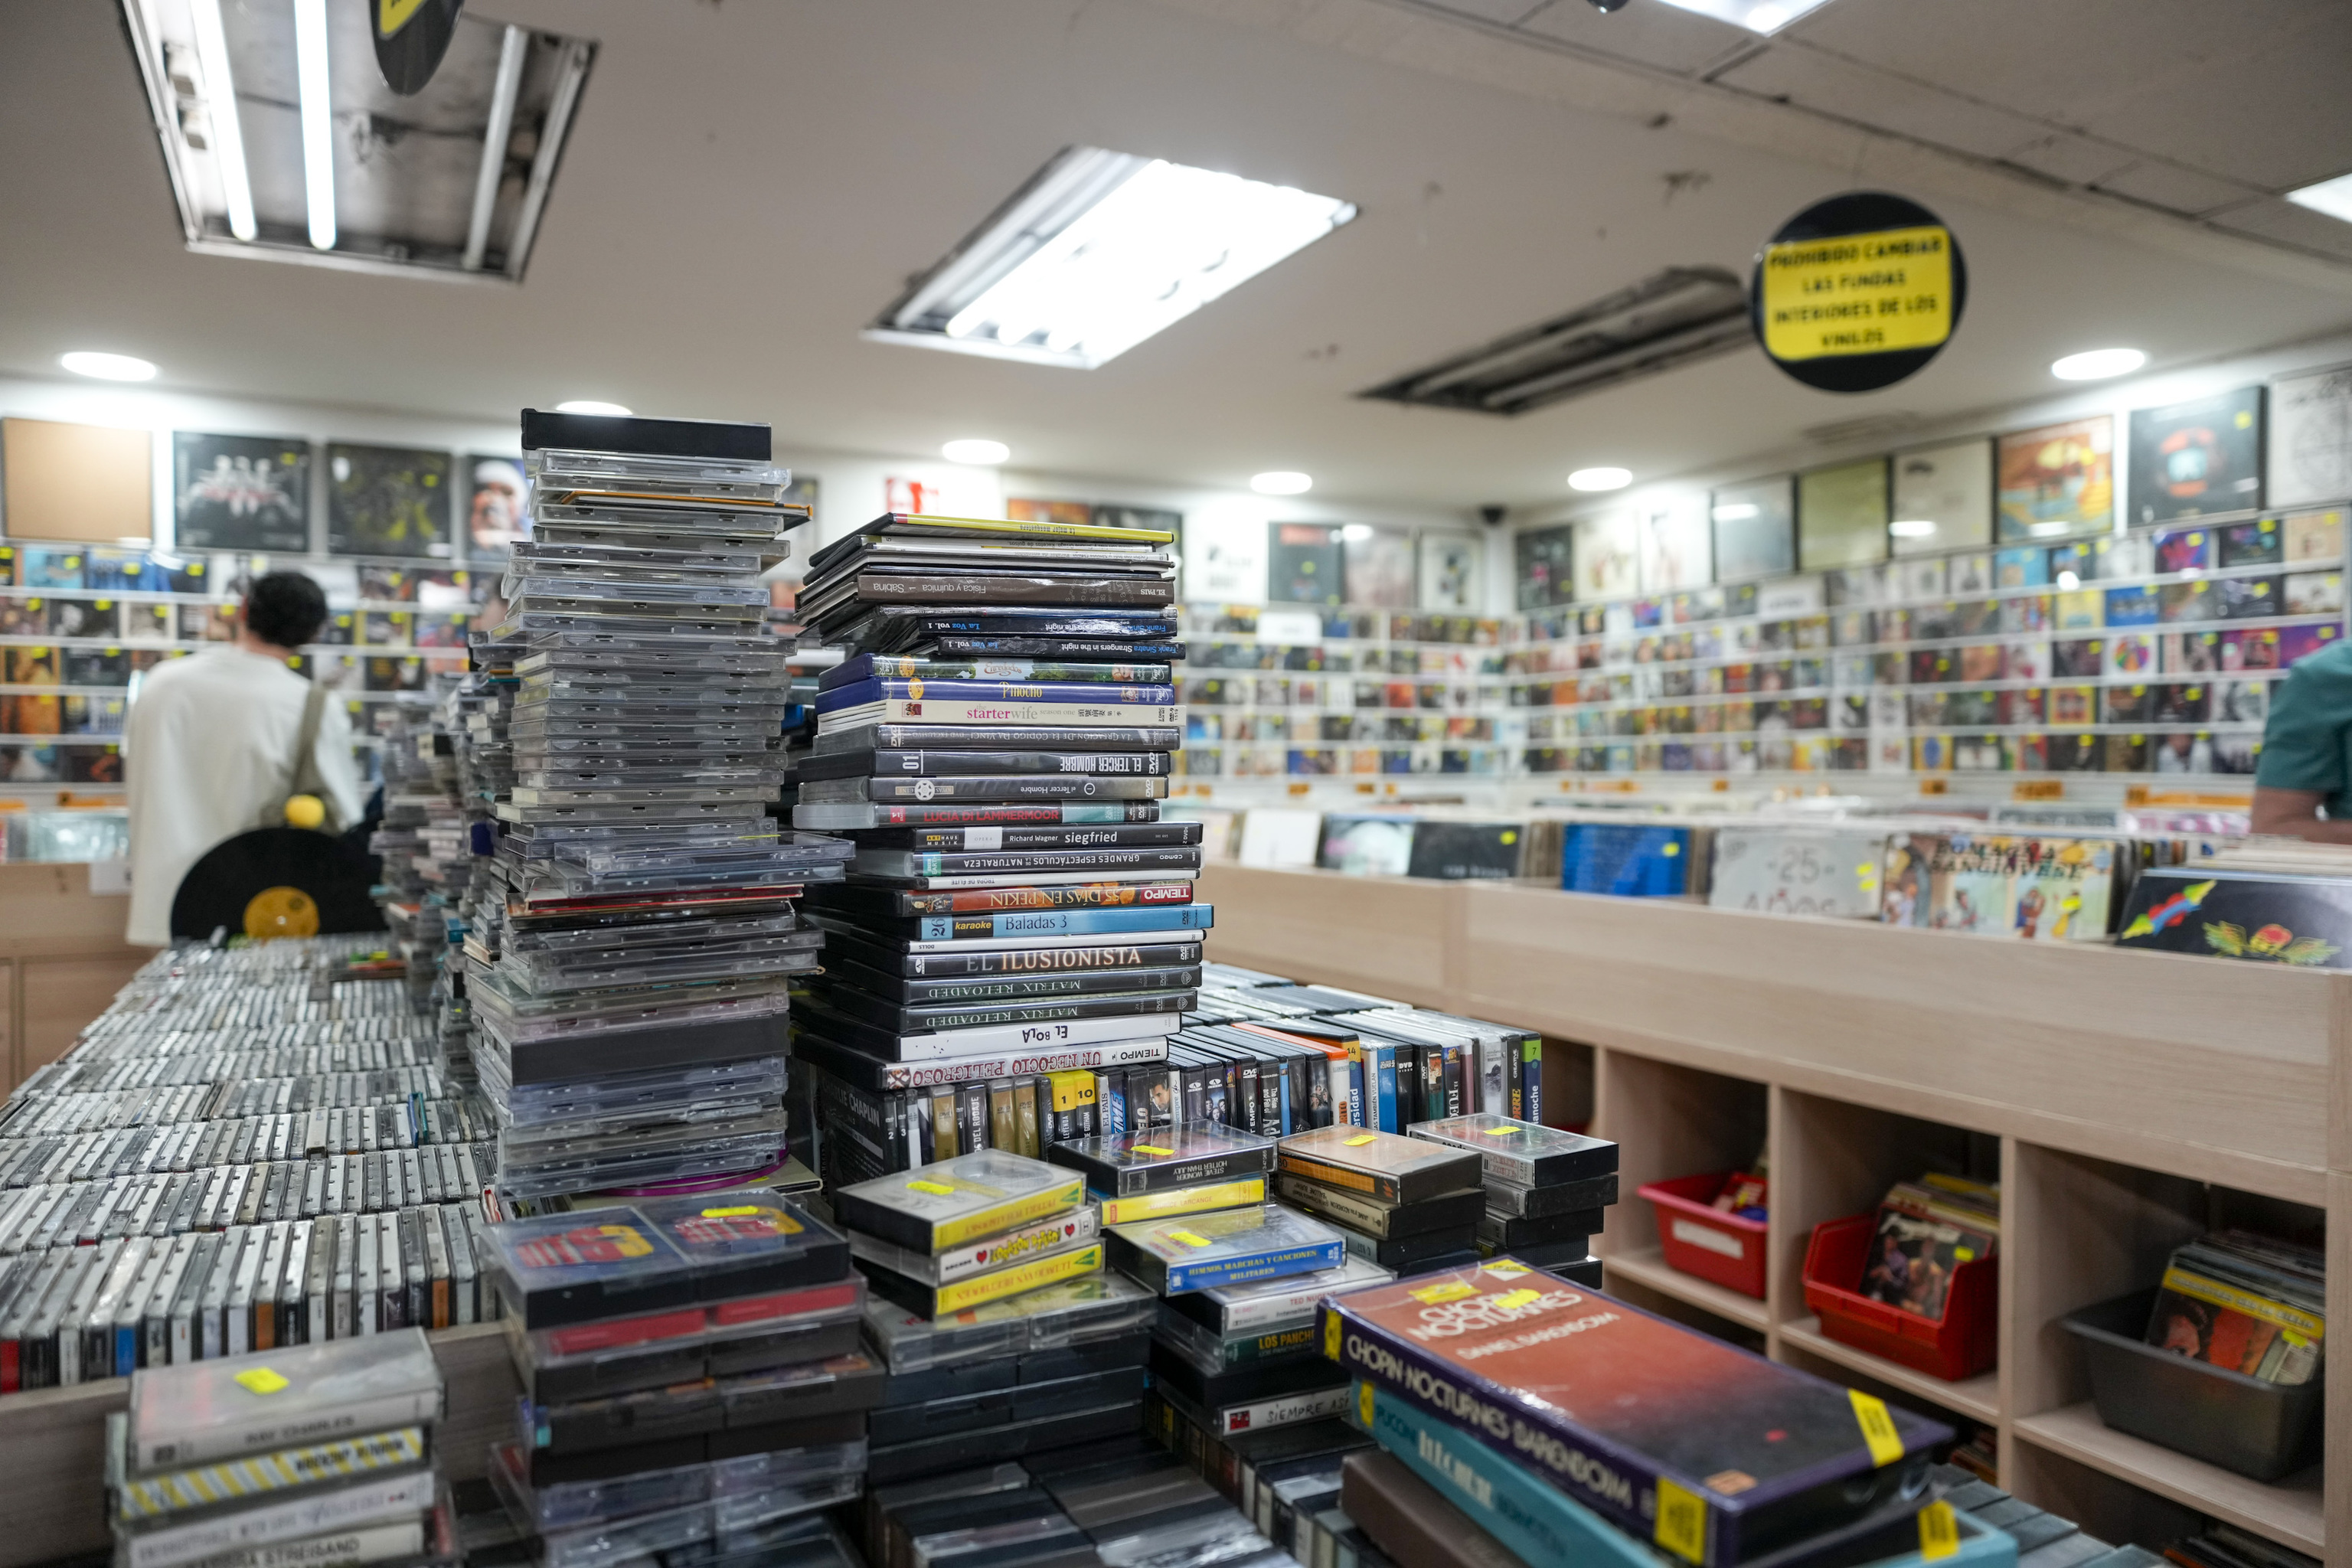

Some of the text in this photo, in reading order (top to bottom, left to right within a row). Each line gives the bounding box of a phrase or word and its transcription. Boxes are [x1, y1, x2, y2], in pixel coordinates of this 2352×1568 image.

[1878, 298, 1900, 315] DE
[1905, 295, 1939, 313] LOS
[874, 583, 904, 593] Sabina
[922, 582, 955, 594] química
[962, 584, 986, 594] Física
[1045, 623, 1063, 632] night
[1061, 642, 1080, 652] night
[1100, 644, 1133, 652] Strangers
[1157, 645, 1176, 654] Frank
[998, 681, 1043, 699] Pinocho
[902, 755, 920, 770] 01
[1060, 756, 1142, 773] EL TERCER HOMBRE
[923, 809, 1060, 822] LUCIA DI LAMMERMOOR
[1034, 835, 1059, 844] Wagner
[1064, 831, 1118, 844] siegfried
[963, 858, 1023, 867] NATURALEZA
[1034, 854, 1140, 866] GRANDES ESPECTÁCULOS
[990, 890, 1120, 910] 55 DÍAS EN PEKÍN
[1144, 888, 1190, 900] TIEMPO
[931, 918, 946, 937] 26
[955, 920, 992, 931] karaoke
[1005, 914, 1068, 931] Baladas 3
[966, 947, 1142, 972] EL ILUSIONISTA
[929, 980, 1081, 998] MATRIX RELOADED
[926, 1006, 1079, 1027] MATRIX RELOADED
[1021, 1025, 1068, 1044] EL BOLA
[1120, 1046, 1161, 1060] TIEMPO
[1347, 1047, 1356, 1055] 14
[1532, 1047, 1537, 1055] 7
[912, 1051, 1102, 1086] UN NEGOCIO PELIGROSO
[1061, 1095, 1067, 1104] 1
[1077, 1089, 1094, 1099] 10
[848, 1093, 880, 1128] CHAPLIN
[958, 1121, 963, 1129] 1
[971, 1096, 981, 1143] DEL RODAJE
[1102, 1115, 1110, 1128] EL
[888, 1132, 894, 1140] 2
[900, 1129, 906, 1137] 3
[1173, 1160, 1228, 1175] HOTTER THAN JULY
[1176, 1167, 1224, 1181] STEVIE WONDER
[1188, 1265, 1223, 1276] HIMNOS
[1223, 1258, 1265, 1270] MARCHAS
[1272, 1250, 1318, 1263] CANCIONES
[1230, 1267, 1276, 1281] MILITARES
[1290, 1297, 1304, 1305] TED
[1259, 1329, 1315, 1350] LOS PANCH
[1347, 1334, 1403, 1381] CHOPIN
[1406, 1362, 1511, 1441] NOCTURNES
